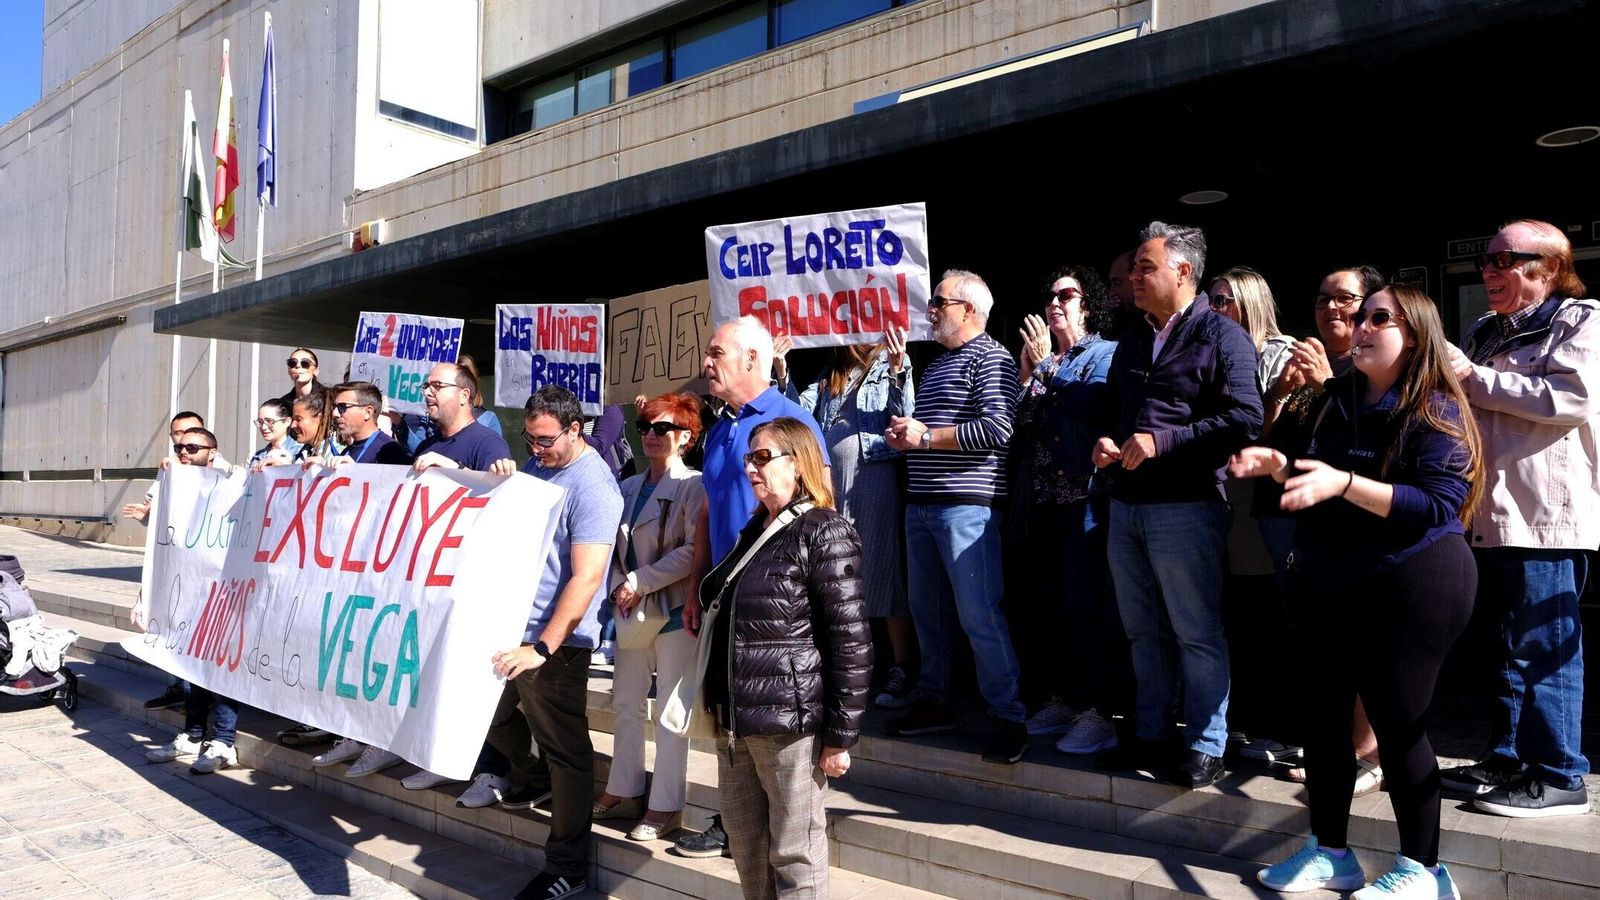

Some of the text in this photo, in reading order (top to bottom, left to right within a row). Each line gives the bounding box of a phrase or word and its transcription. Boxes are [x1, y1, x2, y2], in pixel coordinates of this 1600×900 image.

[719, 219, 904, 280] CEIP LORETO
[499, 307, 598, 354] LOS NIÑOS
[738, 273, 910, 338] SOLUCIÓN
[355, 314, 462, 364] LAS 2 UNIDADES
[253, 477, 491, 588] EXCLUYE
[143, 617, 161, 649] a
[186, 577, 257, 673] NIÑOS
[247, 580, 272, 682] de
[281, 596, 306, 691] la
[317, 590, 421, 709] VEGA
